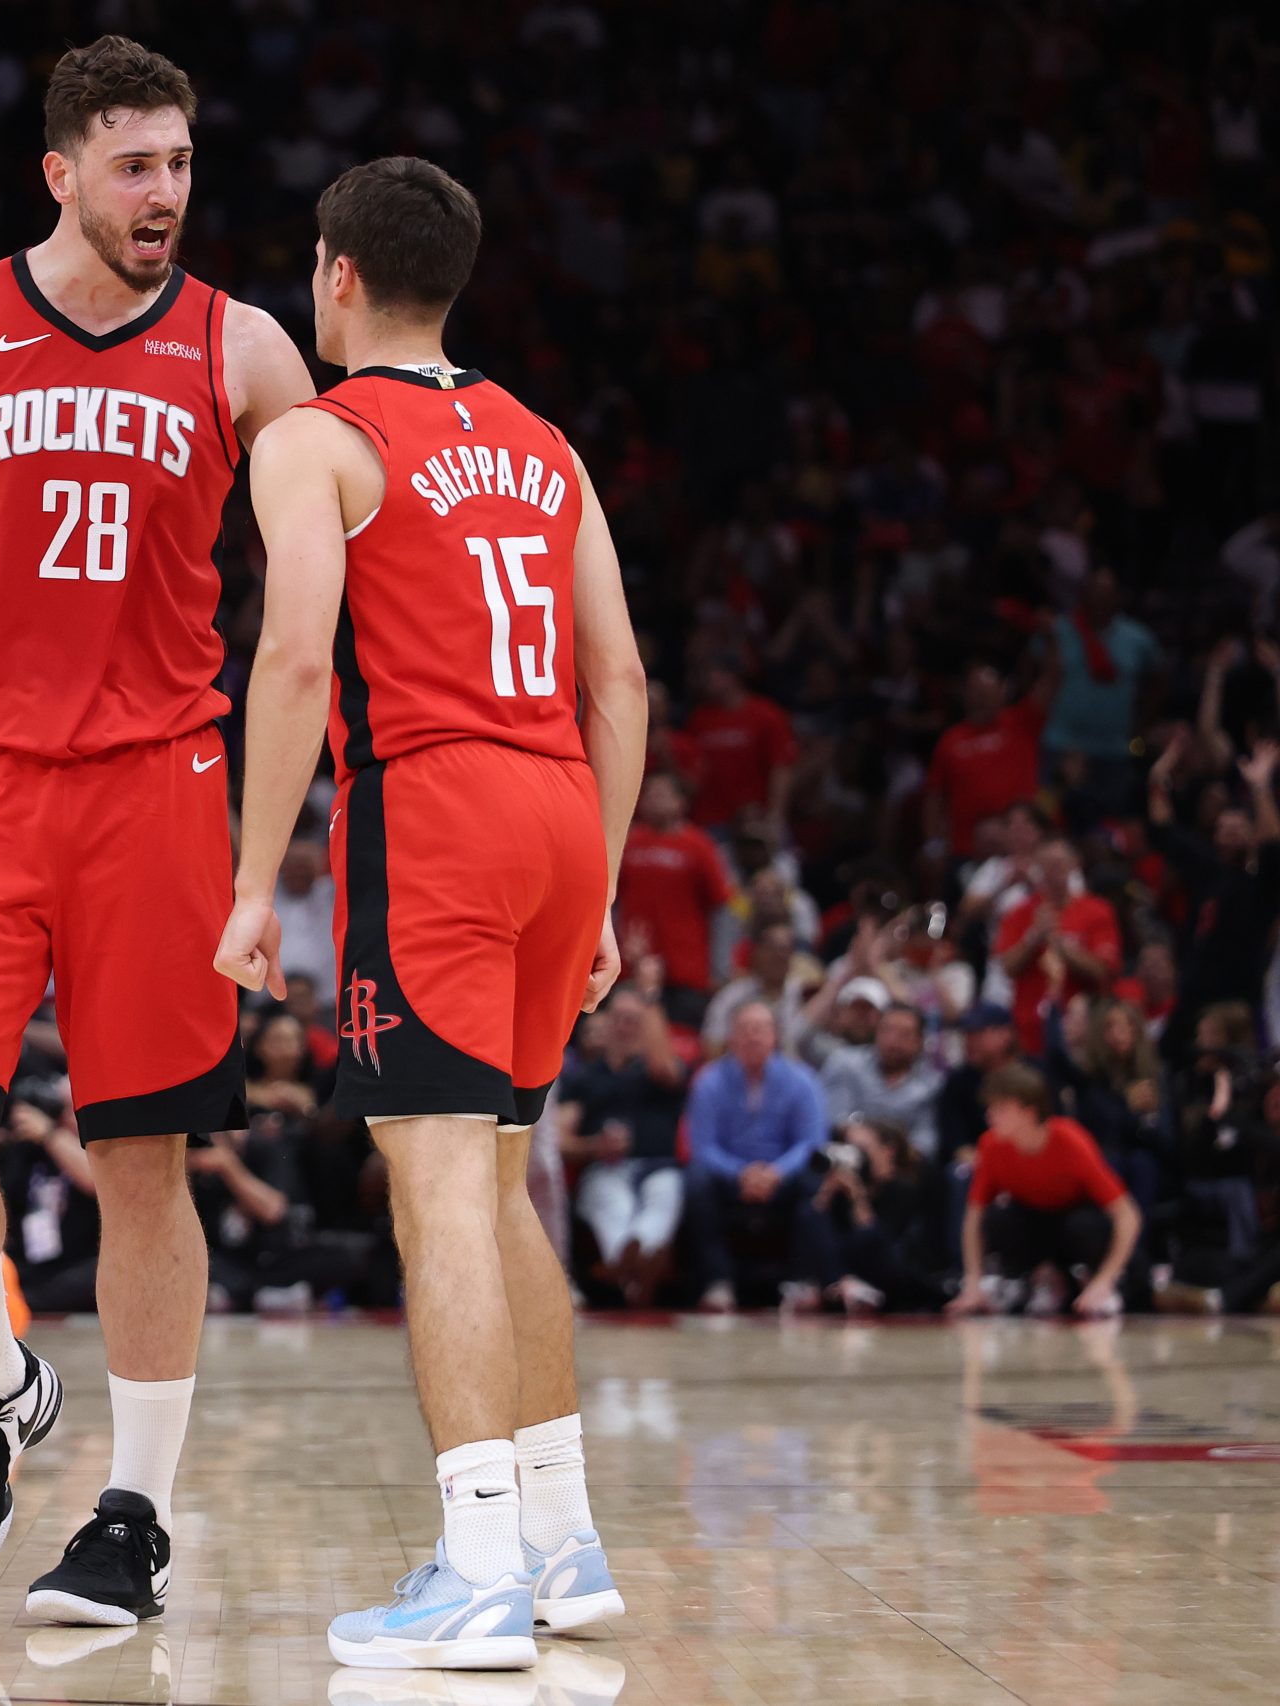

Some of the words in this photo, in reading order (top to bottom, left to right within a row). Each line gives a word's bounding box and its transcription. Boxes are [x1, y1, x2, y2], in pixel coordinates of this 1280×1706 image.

[145, 339, 200, 355] MEMORIAL
[145, 346, 201, 361] HERMANN
[418, 366, 443, 375] NIKE
[411, 445, 566, 517] SHEPPARD
[38, 479, 130, 582] 28
[464, 534, 557, 697] 15
